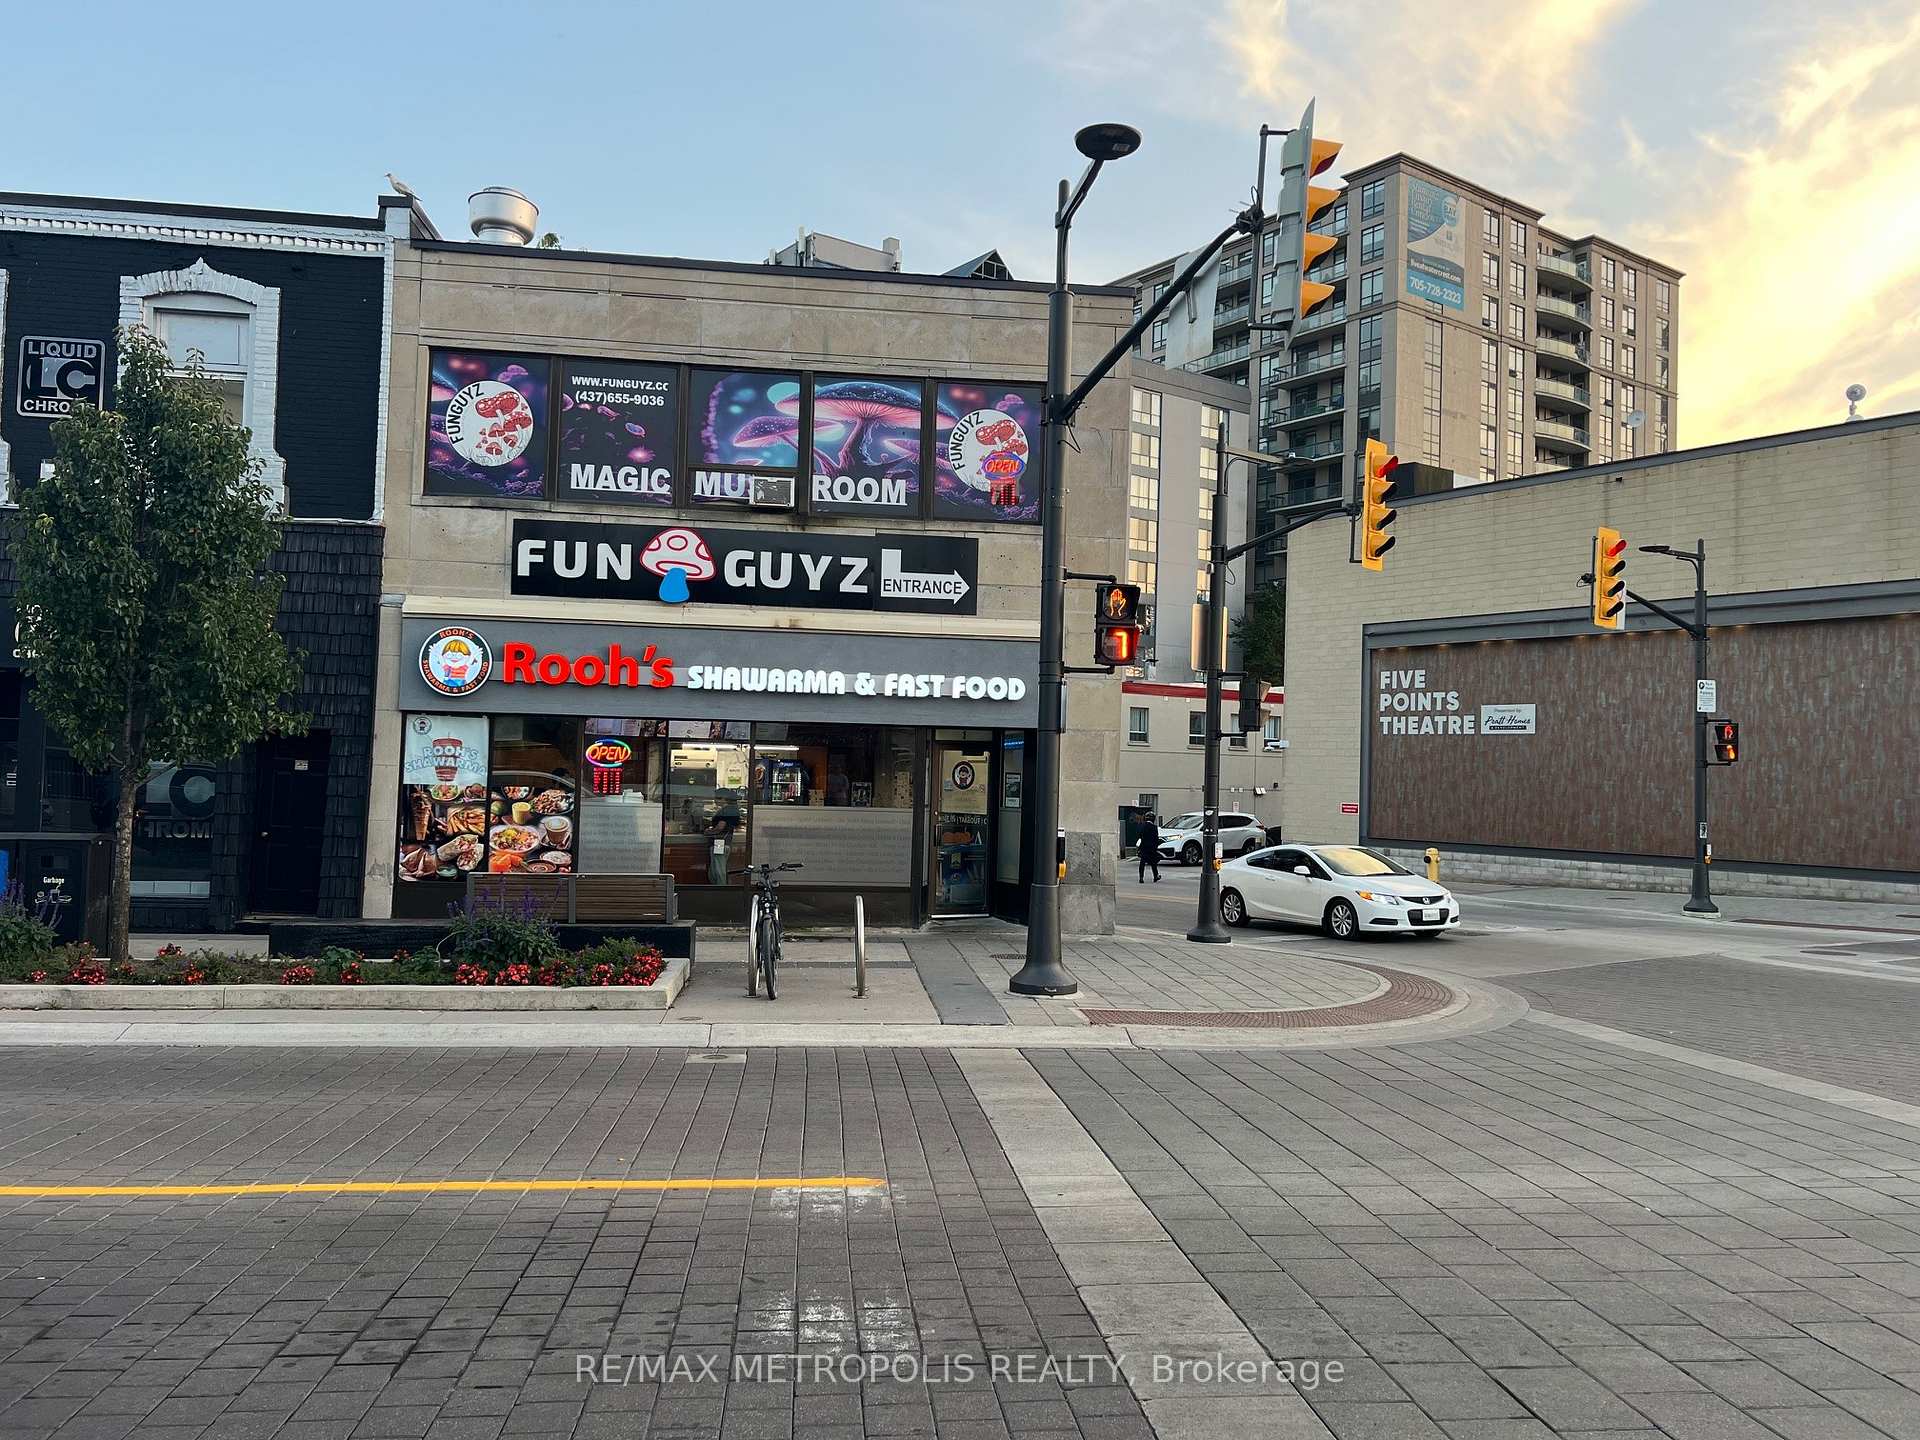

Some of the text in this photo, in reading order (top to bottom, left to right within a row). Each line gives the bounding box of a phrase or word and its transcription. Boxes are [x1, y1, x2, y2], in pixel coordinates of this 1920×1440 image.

[28, 341, 97, 358] LIQUID
[23, 399, 96, 413] CHRO
[575, 391, 665, 406] (437)655-9036
[447, 383, 484, 444] FUNGUYZ
[950, 412, 984, 470] FUNGUYZ
[985, 459, 1019, 473] OPEN
[571, 464, 671, 493] MAGIC
[517, 539, 869, 594] FUN GUYZ
[883, 578, 962, 595] ENTRANCE
[503, 642, 1026, 701] Rooh's SHAWARMA & FAST FOOD
[1380, 670, 1426, 690] FIVE
[1379, 691, 1460, 712] POINTS
[1379, 715, 1475, 735] THEATRE
[588, 745, 627, 761] OPEN
[404, 757, 487, 775] SHAWARMA
[43, 876, 65, 885] Garbage
